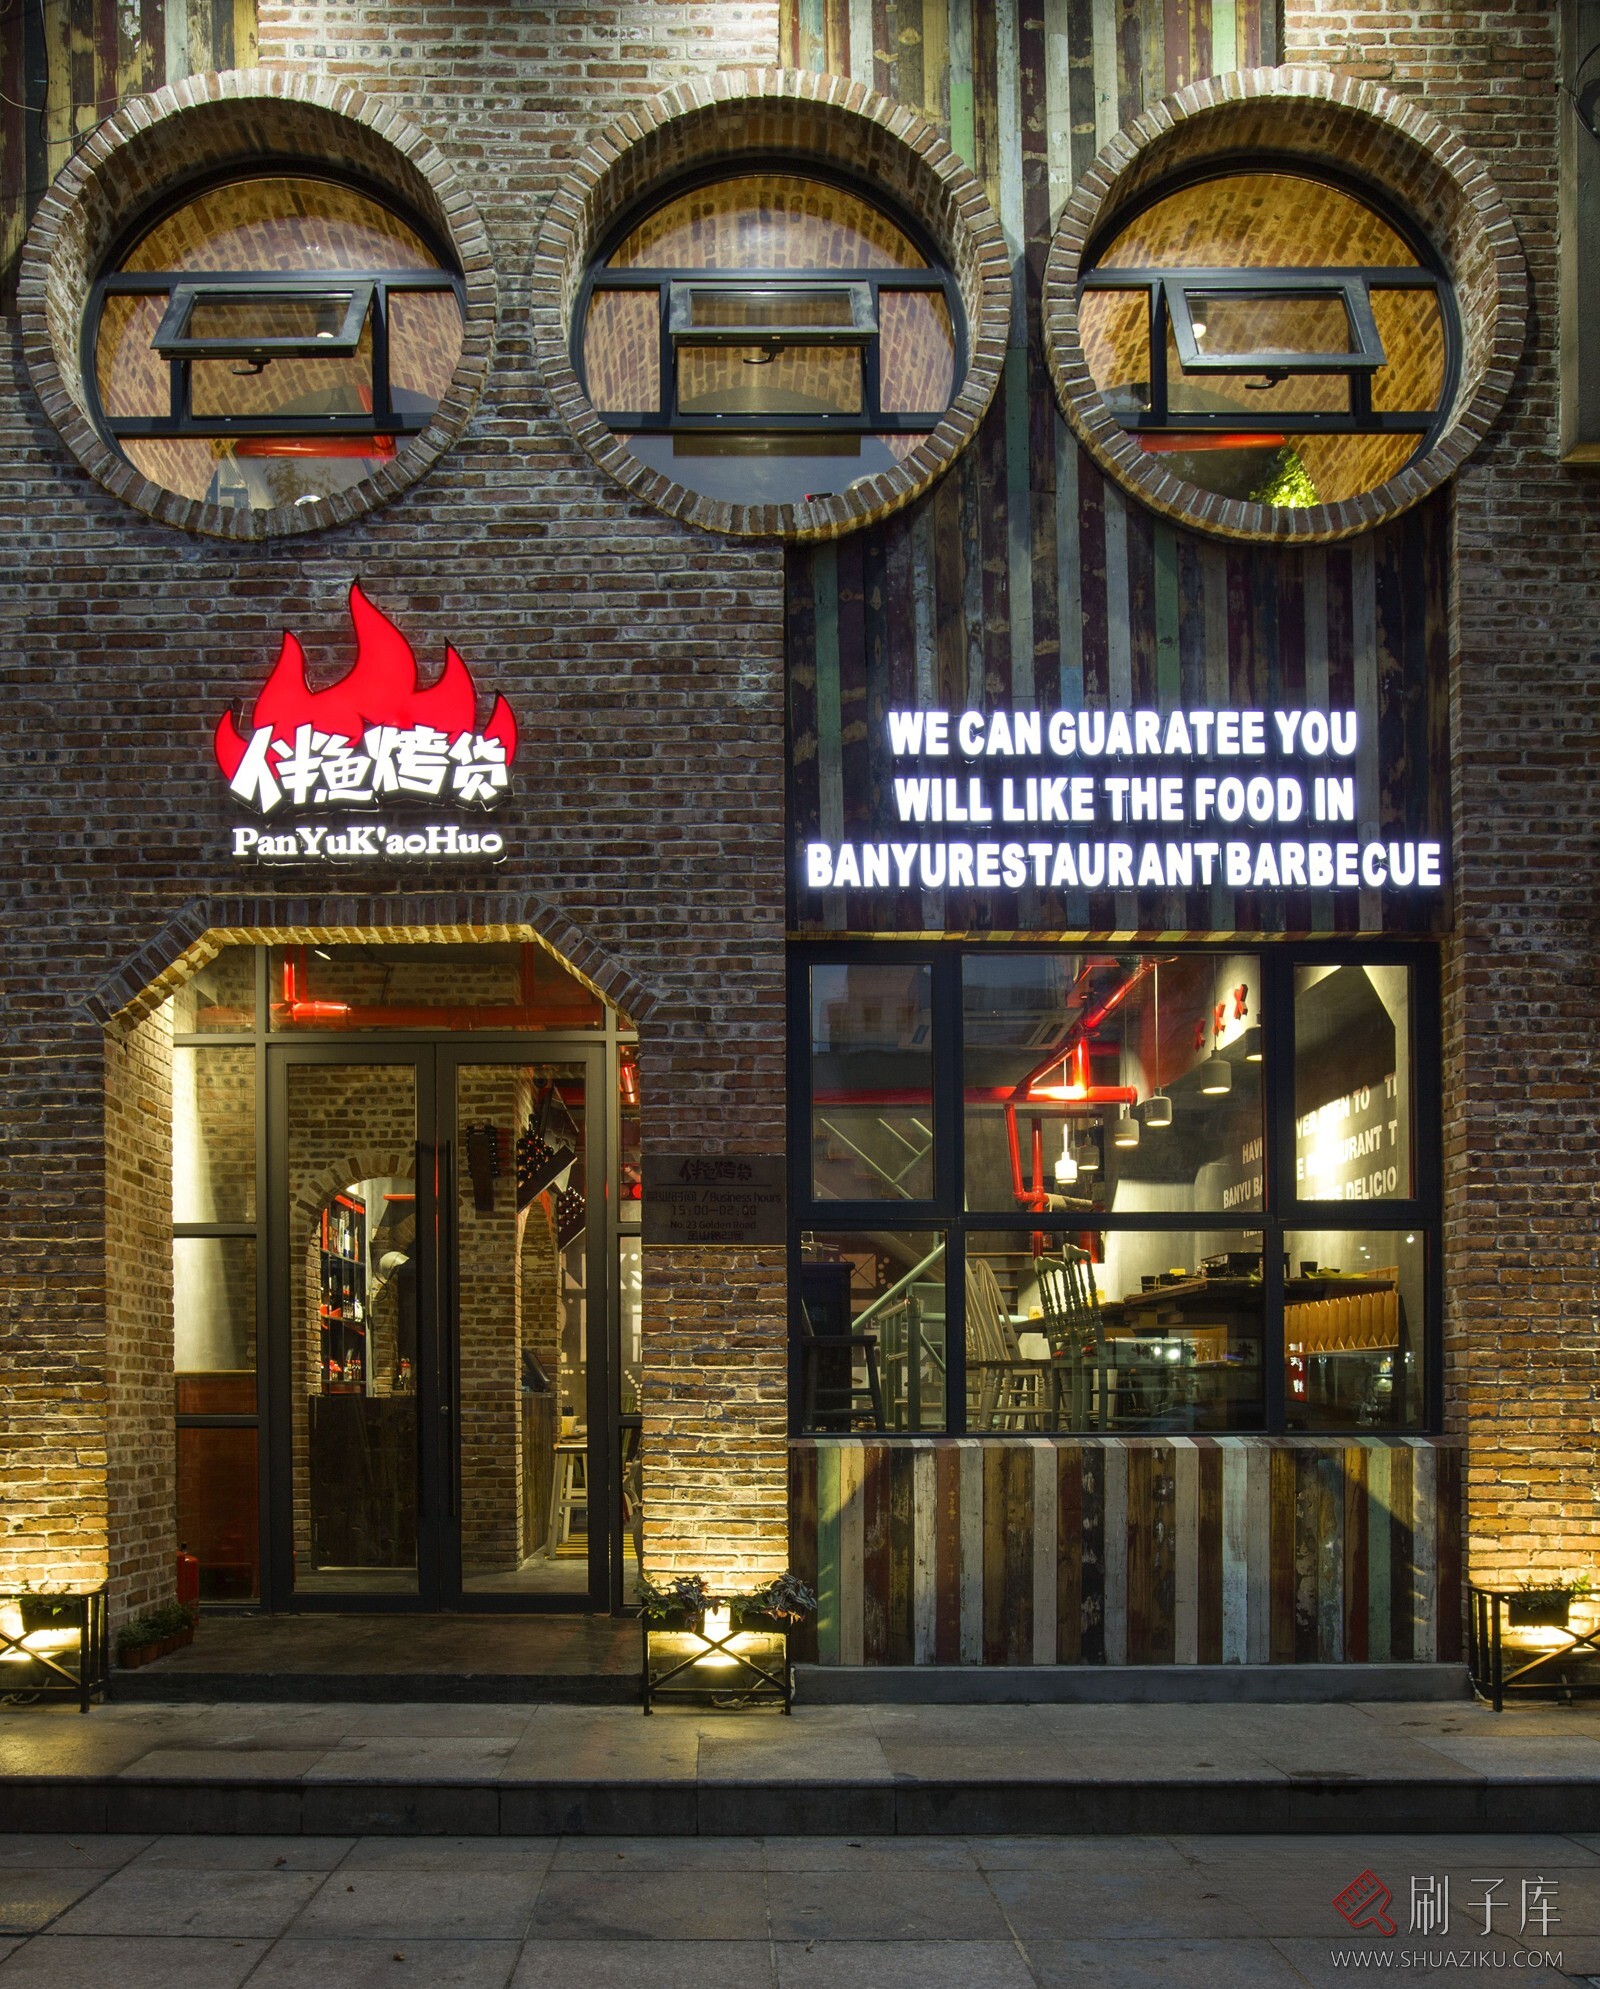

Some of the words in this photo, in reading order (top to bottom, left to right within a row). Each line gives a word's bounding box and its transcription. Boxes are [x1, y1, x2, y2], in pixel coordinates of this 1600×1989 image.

[888, 711, 949, 756] WE
[959, 711, 1041, 756] CAN
[1049, 711, 1265, 756] GUARATEE
[1274, 711, 1357, 756] YOU
[894, 777, 992, 821] WILL
[1003, 777, 1094, 821] LIKE
[1105, 777, 1184, 821] THE
[1195, 777, 1302, 821] FOOD
[1315, 777, 1354, 821] IN
[1226, 842, 1441, 887] BARBECUE
[1353, 1085, 1370, 1113] TO
[753, 1191, 782, 1203] hours
[1223, 1180, 1251, 1209] BANYU
[699, 1220, 732, 1229] Golden
[733, 1221, 757, 1229] Road
